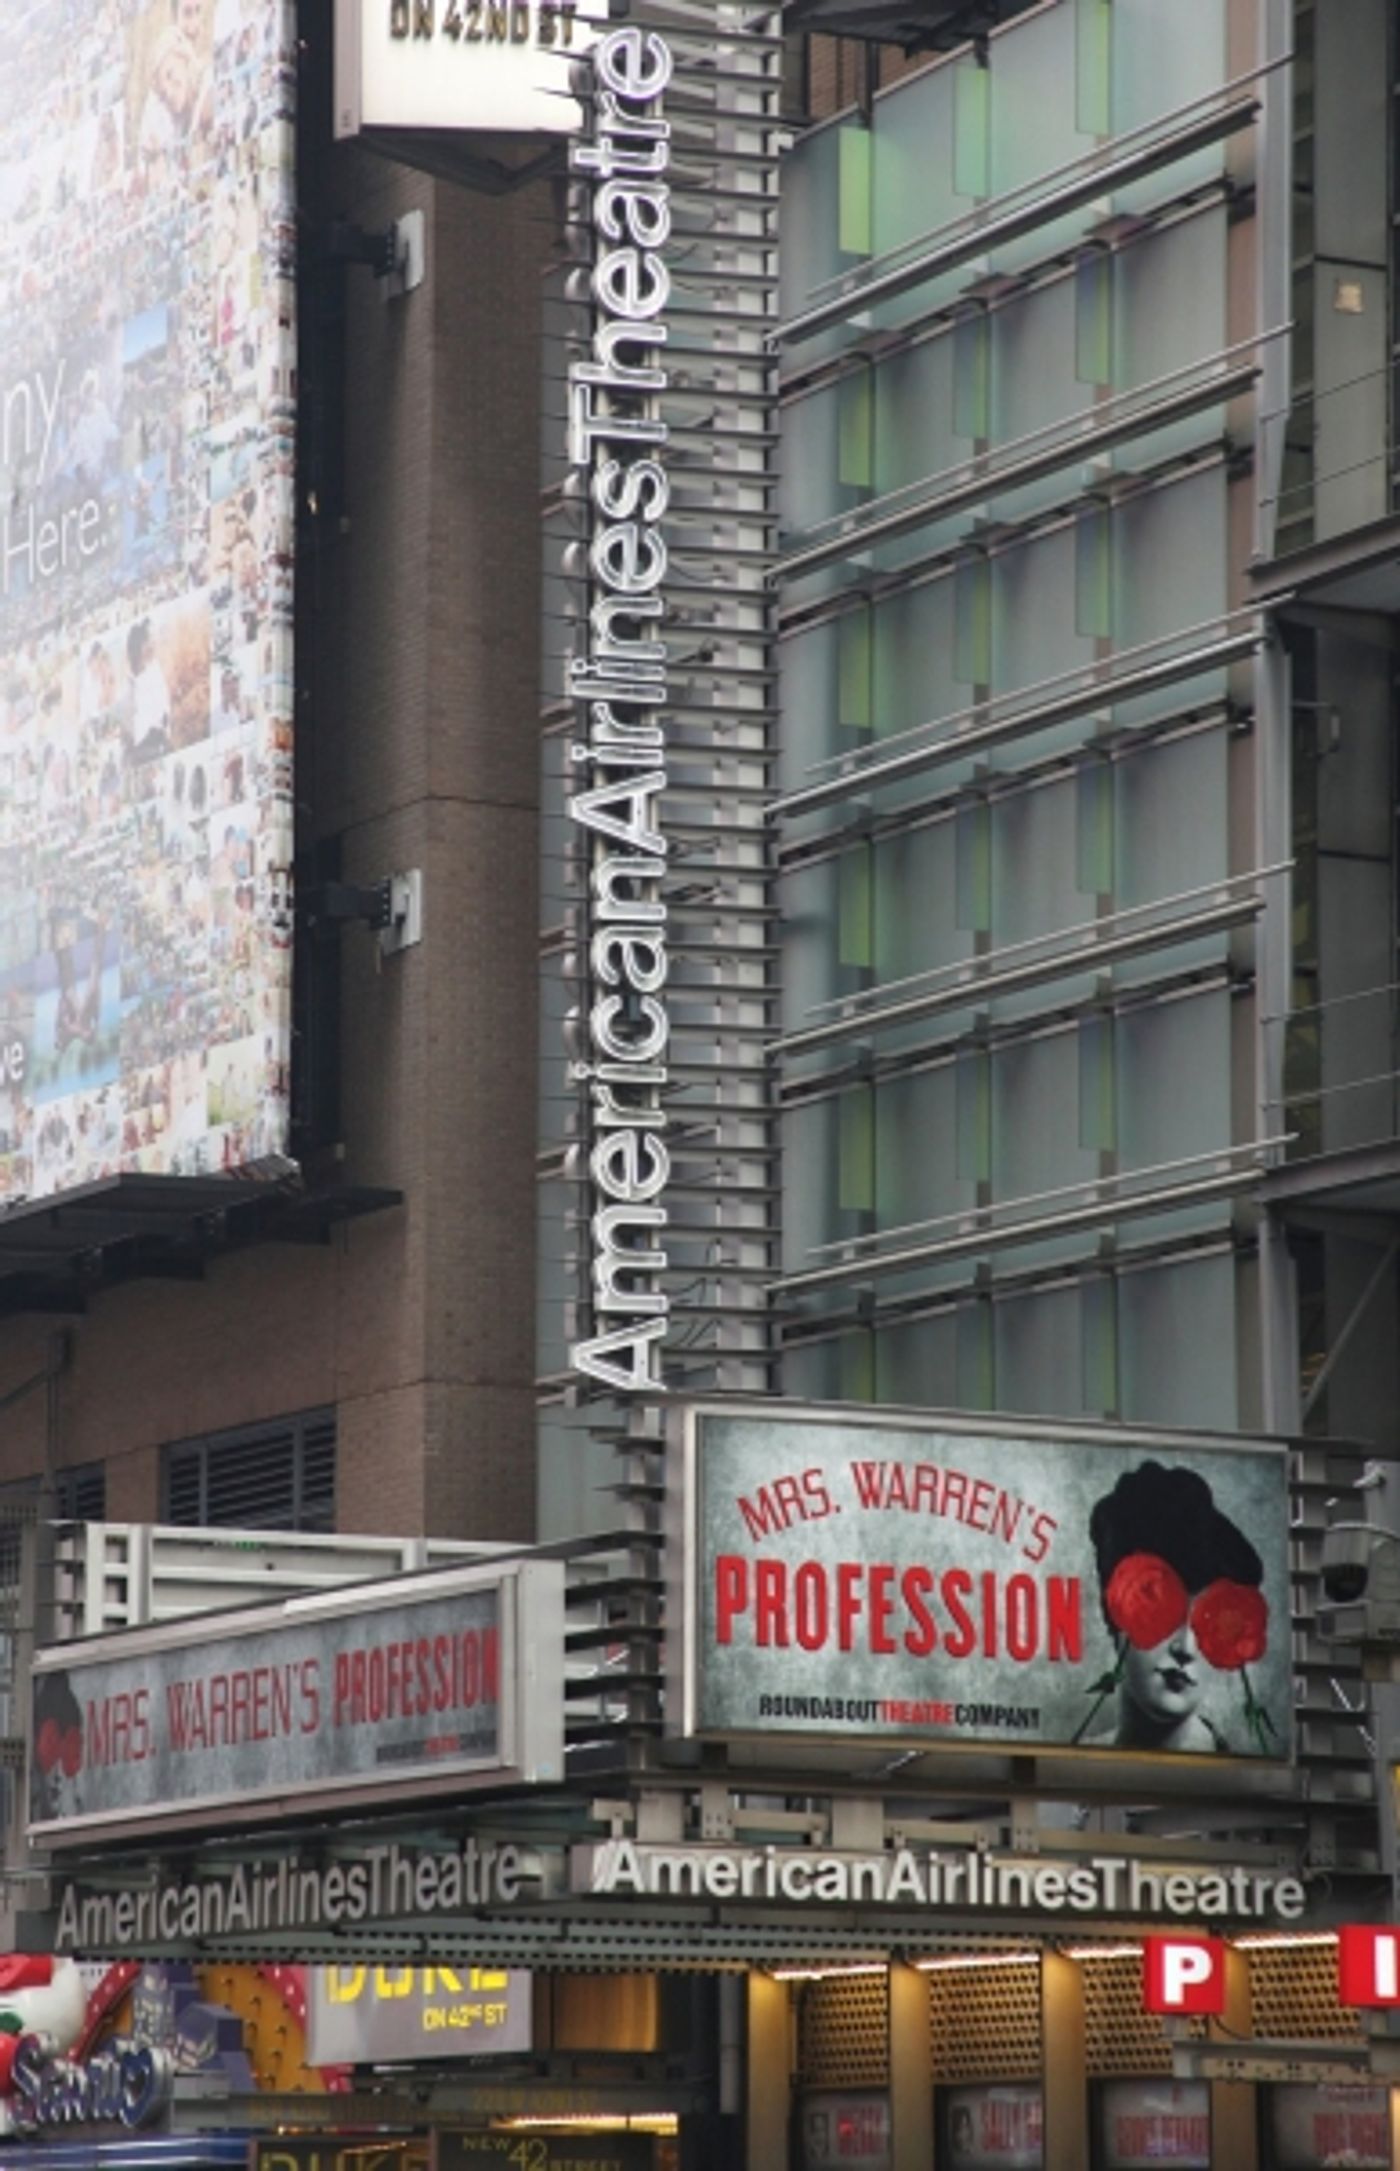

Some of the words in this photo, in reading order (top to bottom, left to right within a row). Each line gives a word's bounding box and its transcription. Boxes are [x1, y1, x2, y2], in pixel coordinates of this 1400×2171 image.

[390, 0, 436, 41] ON
[4, 497, 108, 594] Here.
[570, 27, 674, 1391] AmericanAirlinesTheatre
[737, 1468, 842, 1543] MRS.
[850, 1460, 1058, 1563] WARREN'S
[715, 1555, 1083, 1663] PROFESSION
[88, 1688, 156, 1768] MRS.
[166, 1658, 320, 1752] WARREN'S
[333, 1628, 498, 1726] PROFESSION
[57, 1841, 520, 1949] AmericanAirlinesTheatre
[594, 1841, 1306, 1918] AmericanAirlinesTheatre
[1163, 1944, 1213, 2005] P
